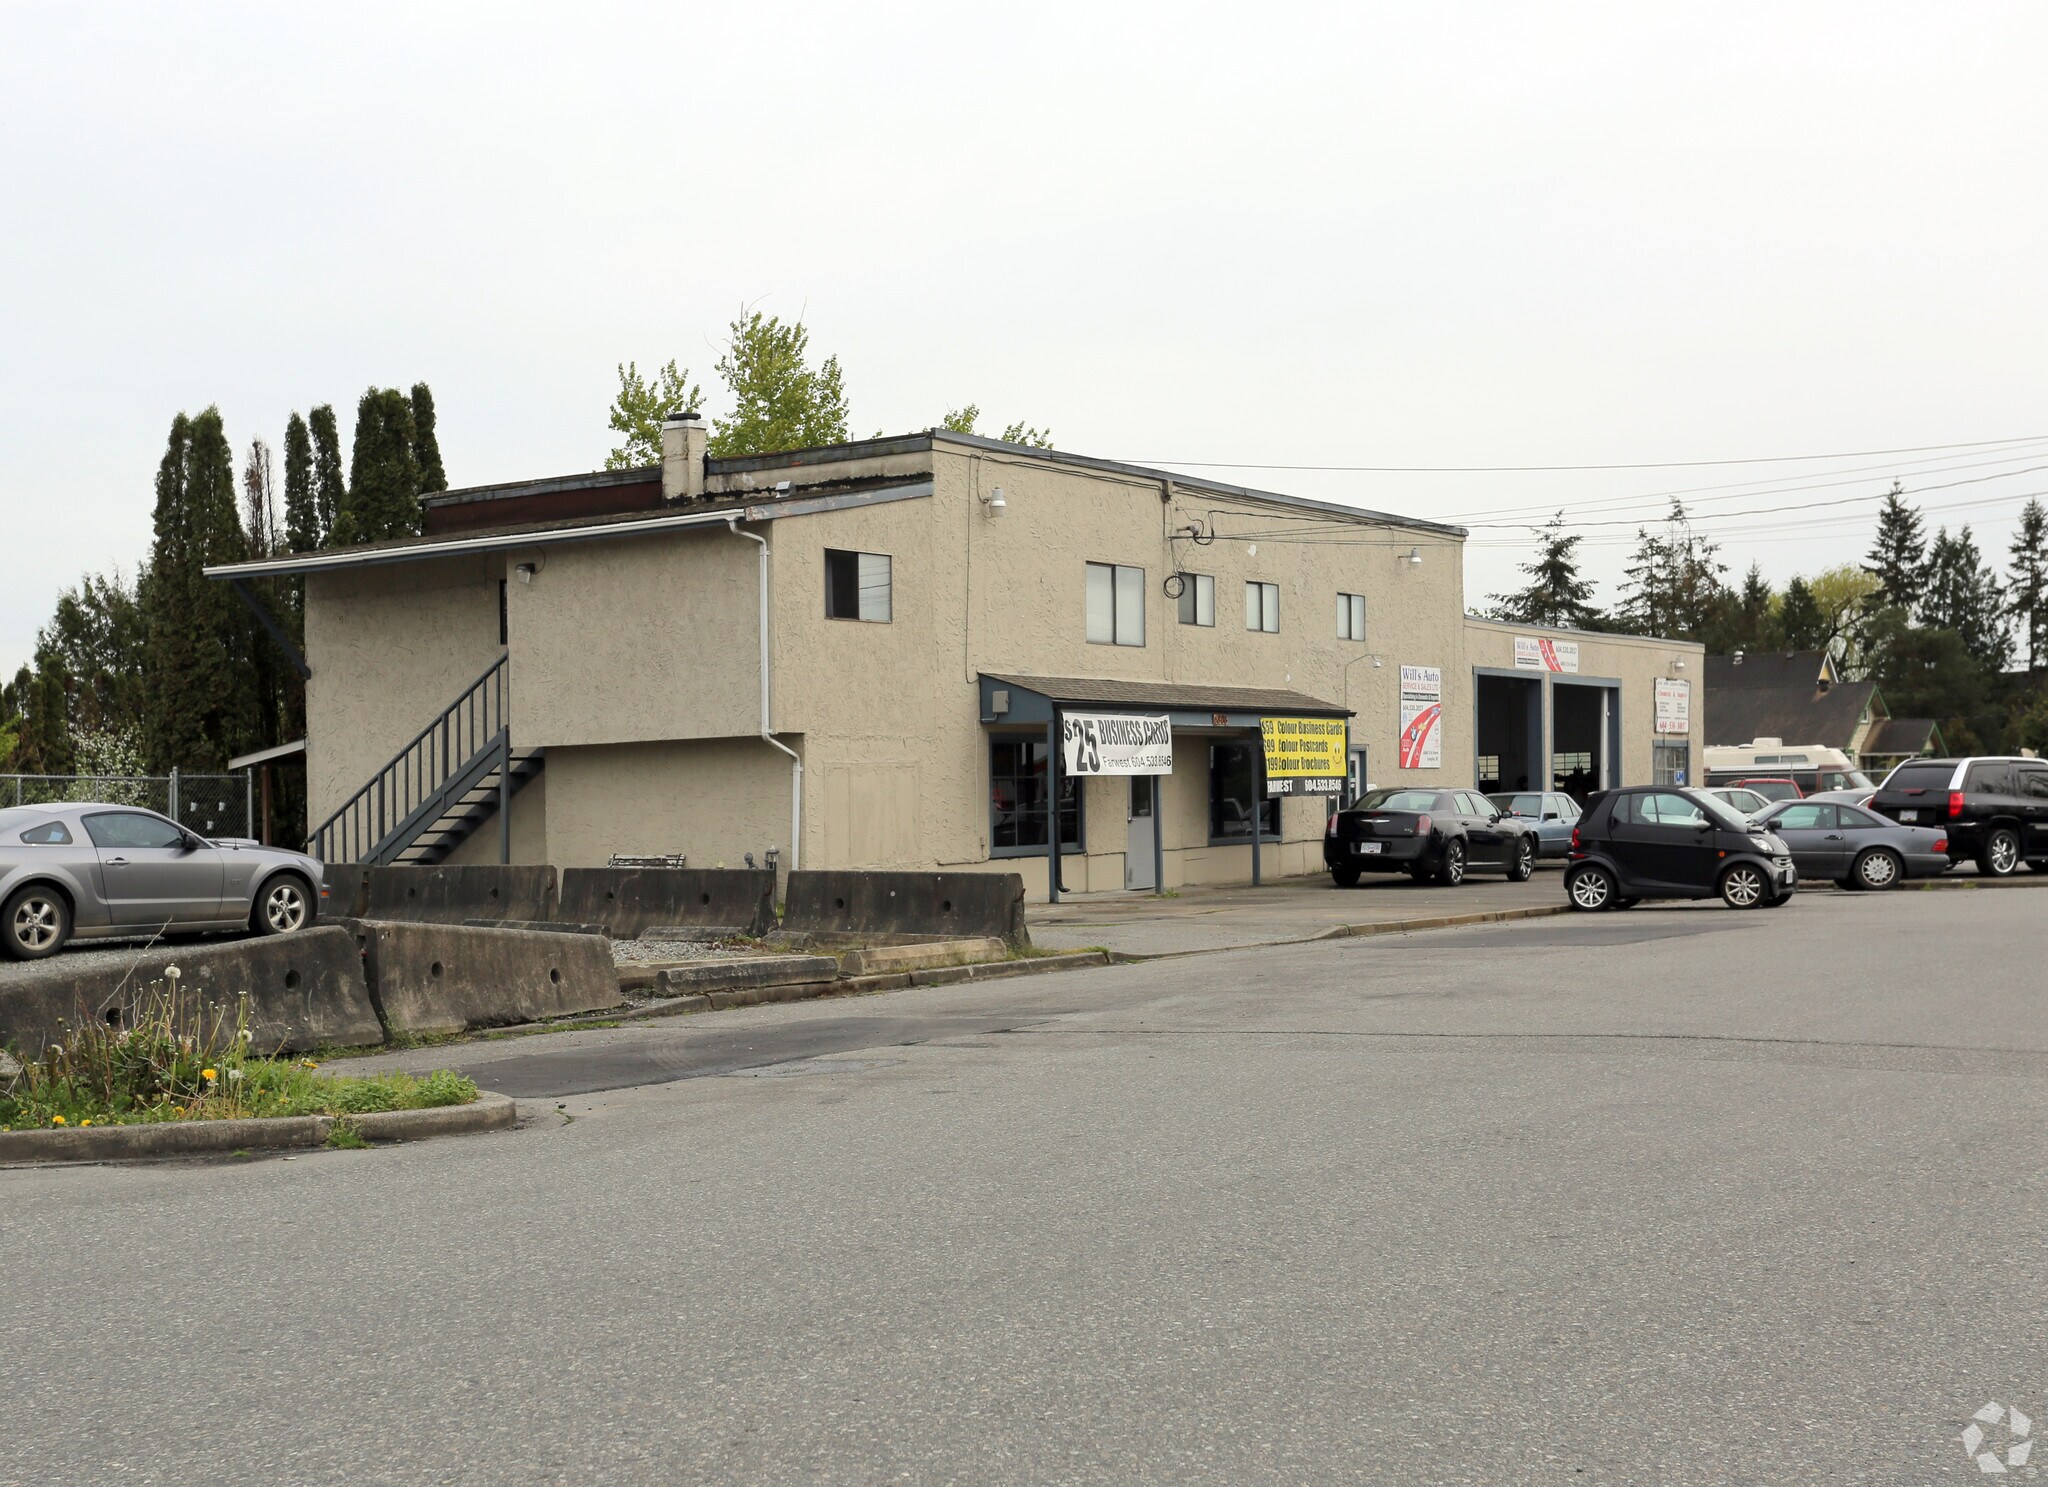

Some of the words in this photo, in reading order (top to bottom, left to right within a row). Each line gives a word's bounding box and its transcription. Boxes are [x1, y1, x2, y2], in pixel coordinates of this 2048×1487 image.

[1402, 667, 1422, 681] Will's
[1423, 669, 1439, 682] Auto
[1402, 682, 1417, 691] SERVICE
[1420, 683, 1432, 691] SALES
[1098, 719, 1143, 746] BUSINESS
[1142, 719, 1169, 746] CARDS
[1262, 720, 1274, 735] $59
[1277, 720, 1297, 735] Colour
[1298, 721, 1325, 735] Business
[1326, 722, 1343, 736] Cards
[1299, 739, 1328, 752] Postcards
[1102, 755, 1131, 768] Farwest
[1300, 757, 1330, 770] Brochures
